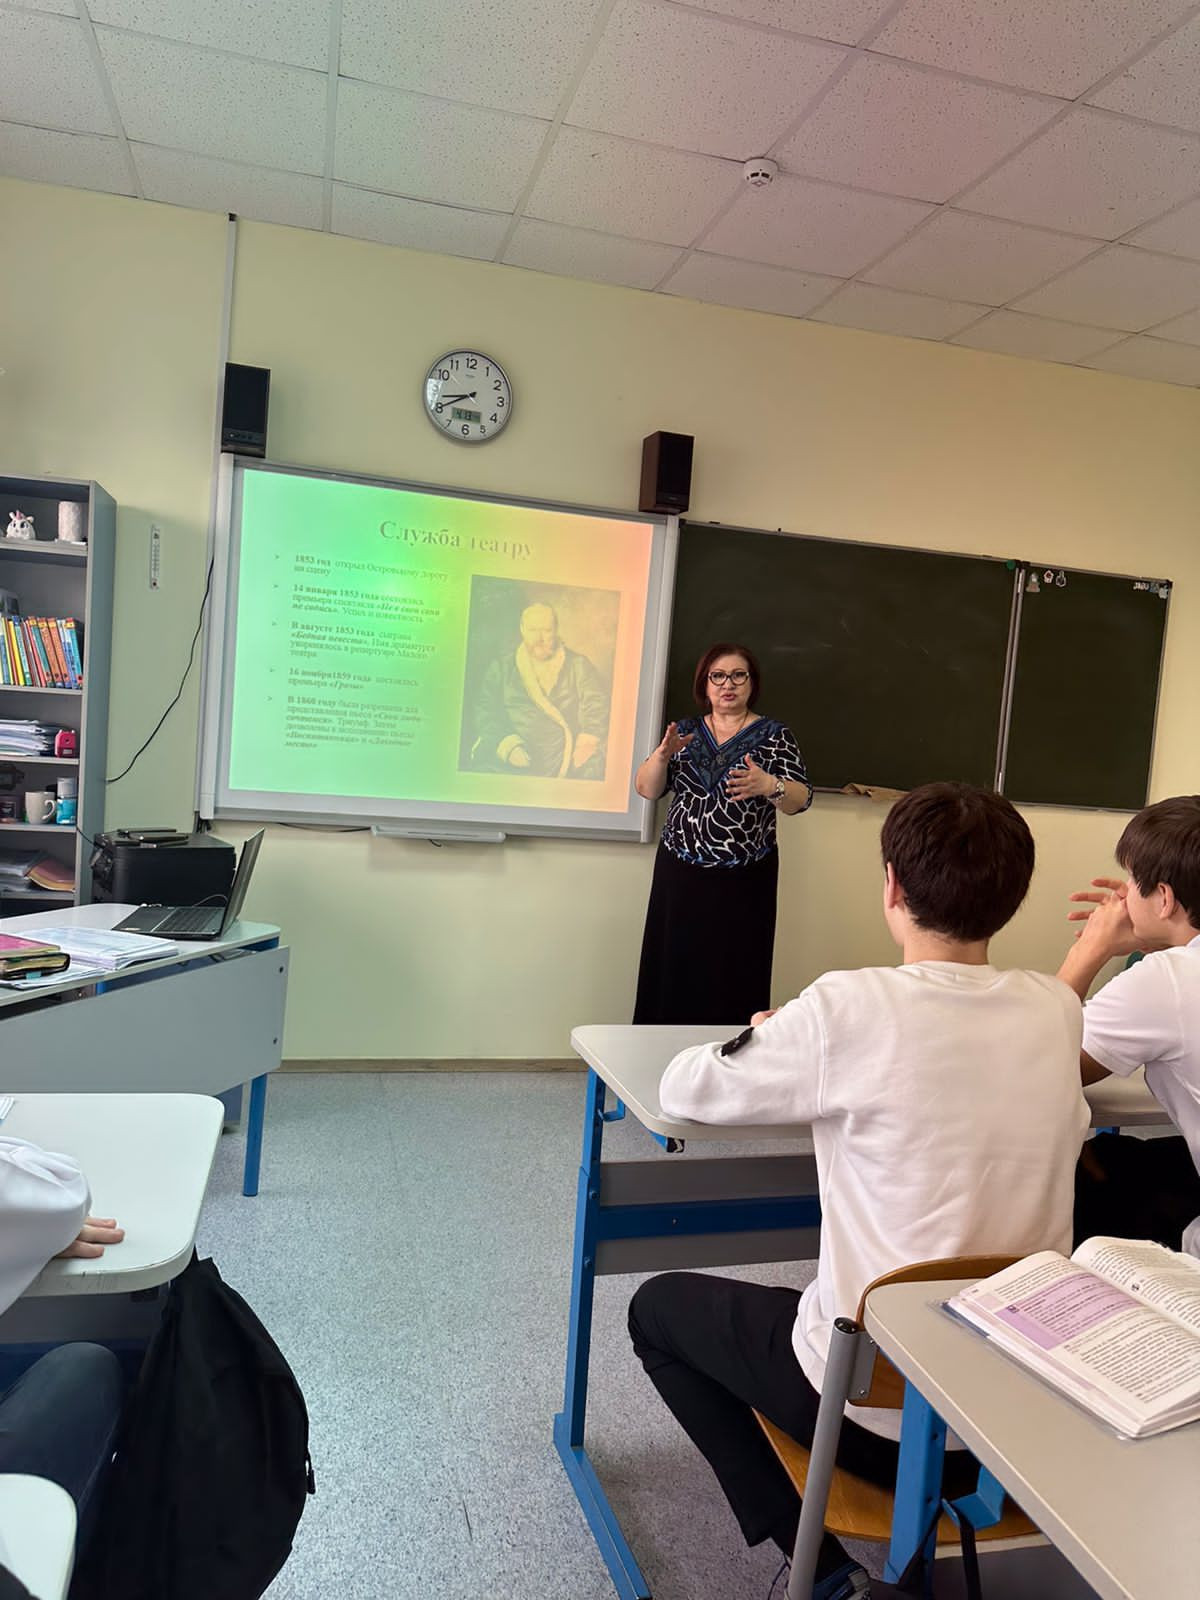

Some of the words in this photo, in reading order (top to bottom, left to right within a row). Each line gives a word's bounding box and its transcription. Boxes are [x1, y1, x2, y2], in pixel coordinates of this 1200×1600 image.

[450, 359, 460, 371] 11
[466, 358, 478, 370] 12
[438, 369, 450, 381] 10
[485, 366, 490, 377] 1
[493, 380, 502, 391] 2
[496, 396, 505, 407] 3
[435, 402, 444, 414] 8
[445, 419, 452, 429] 7
[489, 413, 498, 424] 4
[461, 424, 470, 435] 6
[480, 425, 487, 434] 5
[379, 520, 460, 547] Служба
[471, 536, 533, 560] театру
[295, 554, 315, 564] 1853
[294, 584, 304, 592] 14
